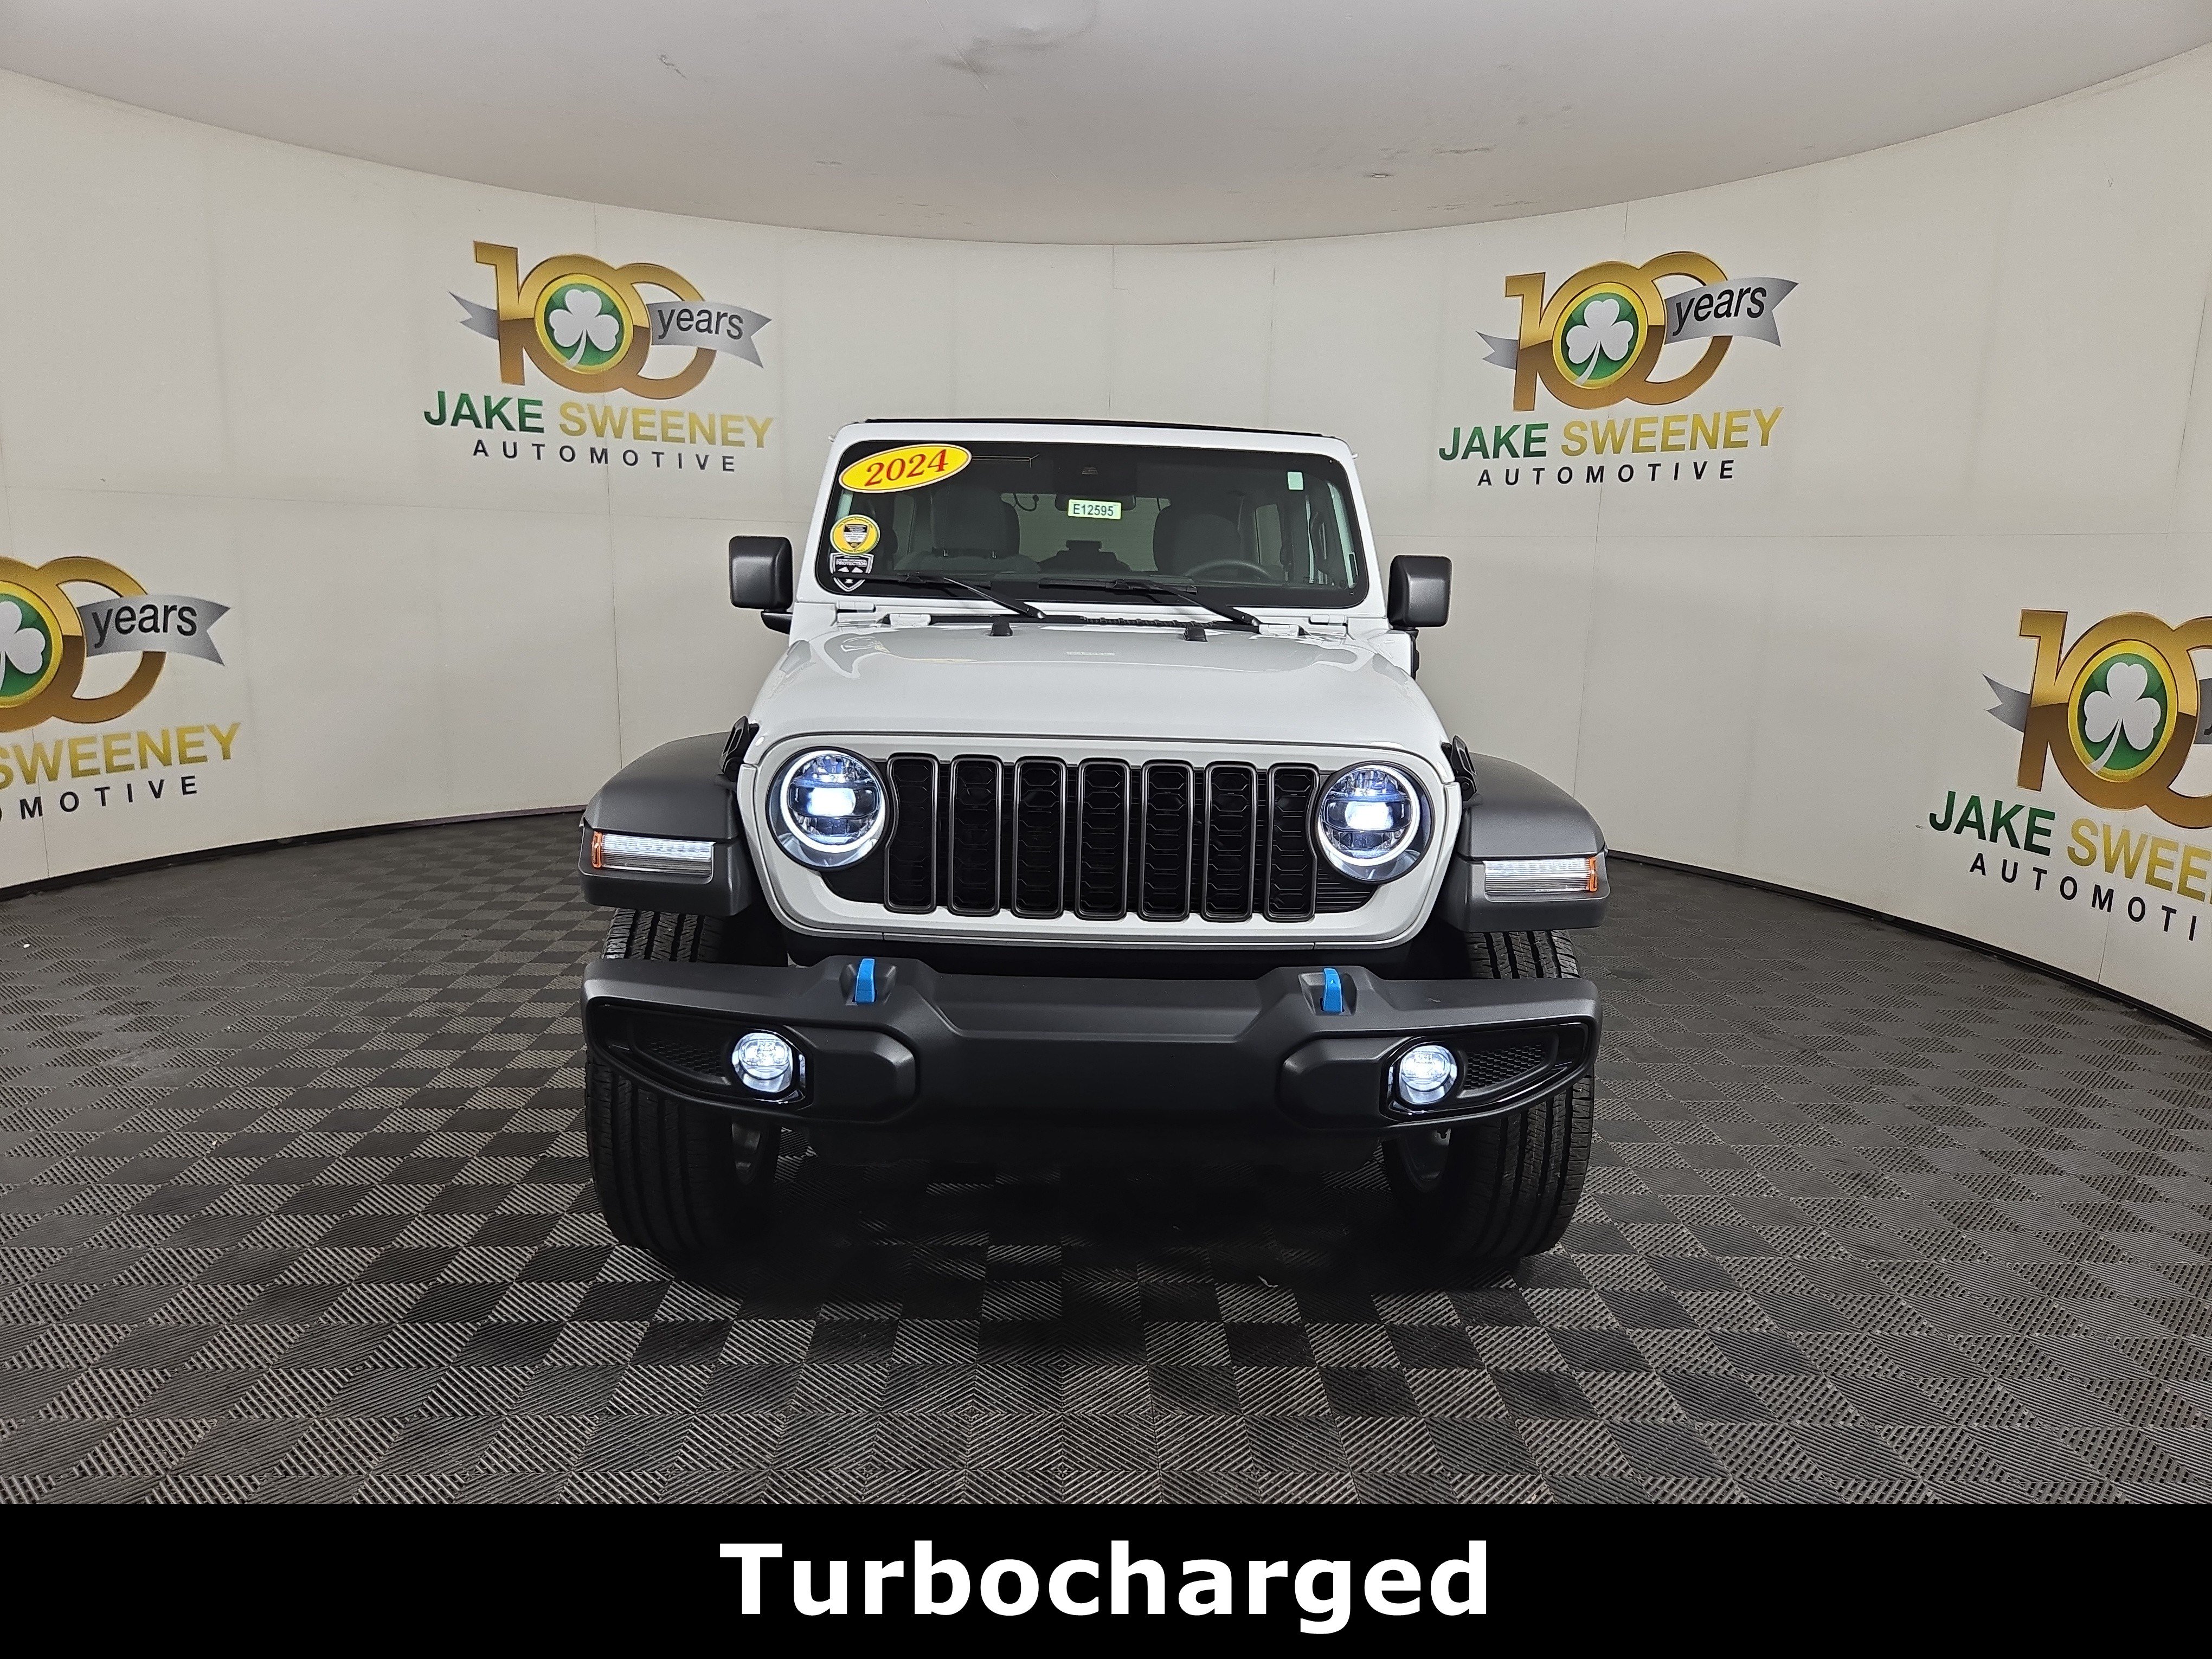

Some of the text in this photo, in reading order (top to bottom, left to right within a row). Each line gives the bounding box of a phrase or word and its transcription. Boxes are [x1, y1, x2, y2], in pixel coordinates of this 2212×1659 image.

[473, 241, 743, 400] 100 years
[1505, 251, 1766, 411] 100 years
[423, 391, 773, 449] JAKE SWEENEY
[1439, 407, 1784, 461] JAKE SWEENEY
[473, 439, 735, 472] AUTOMOTIVE
[864, 448, 949, 487] 2024
[1477, 460, 1734, 486] AUTOMOTIVE
[1073, 504, 1114, 516] E12595
[92, 603, 197, 649] years
[1929, 790, 2212, 906] JAKE SWEE
